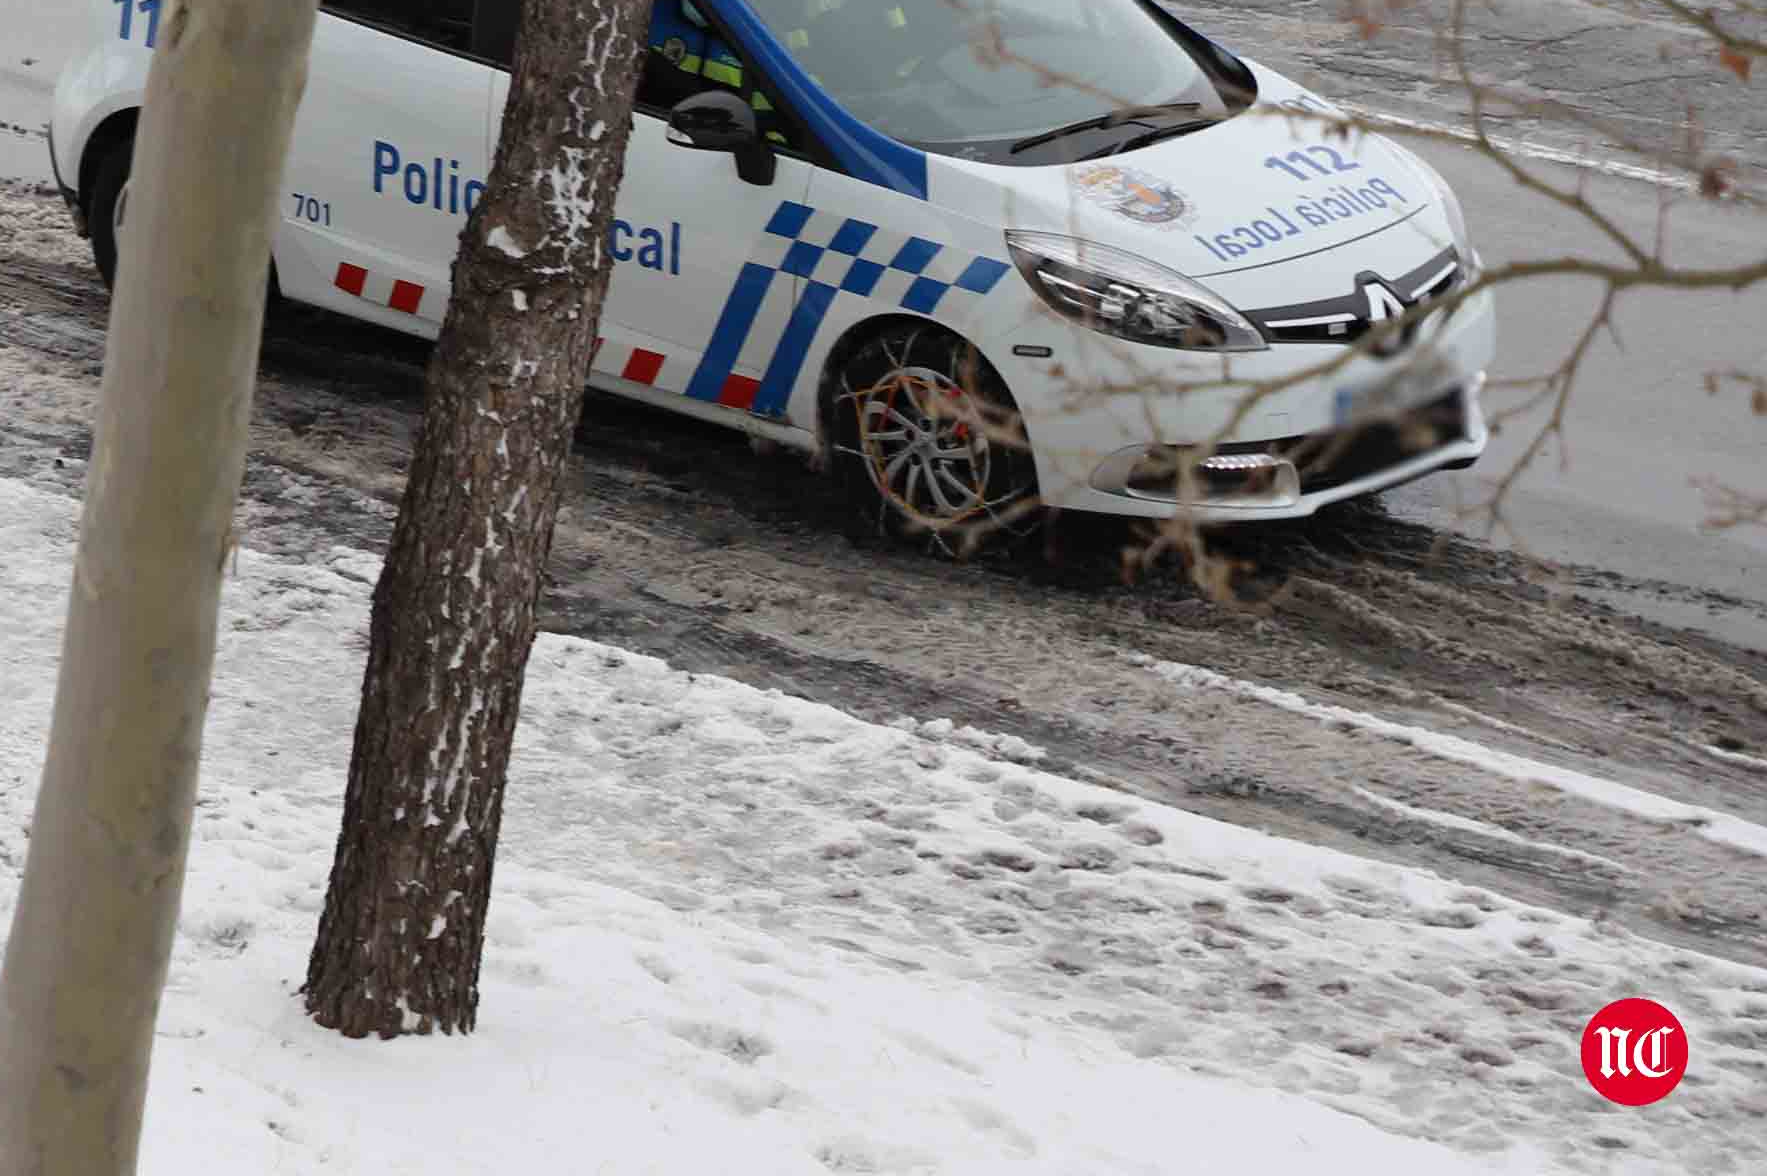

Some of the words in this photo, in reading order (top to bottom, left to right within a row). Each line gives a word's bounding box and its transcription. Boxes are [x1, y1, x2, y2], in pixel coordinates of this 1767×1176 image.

[1264, 145, 1360, 181] 112
[292, 192, 331, 226] 701
[607, 219, 681, 276] cal
